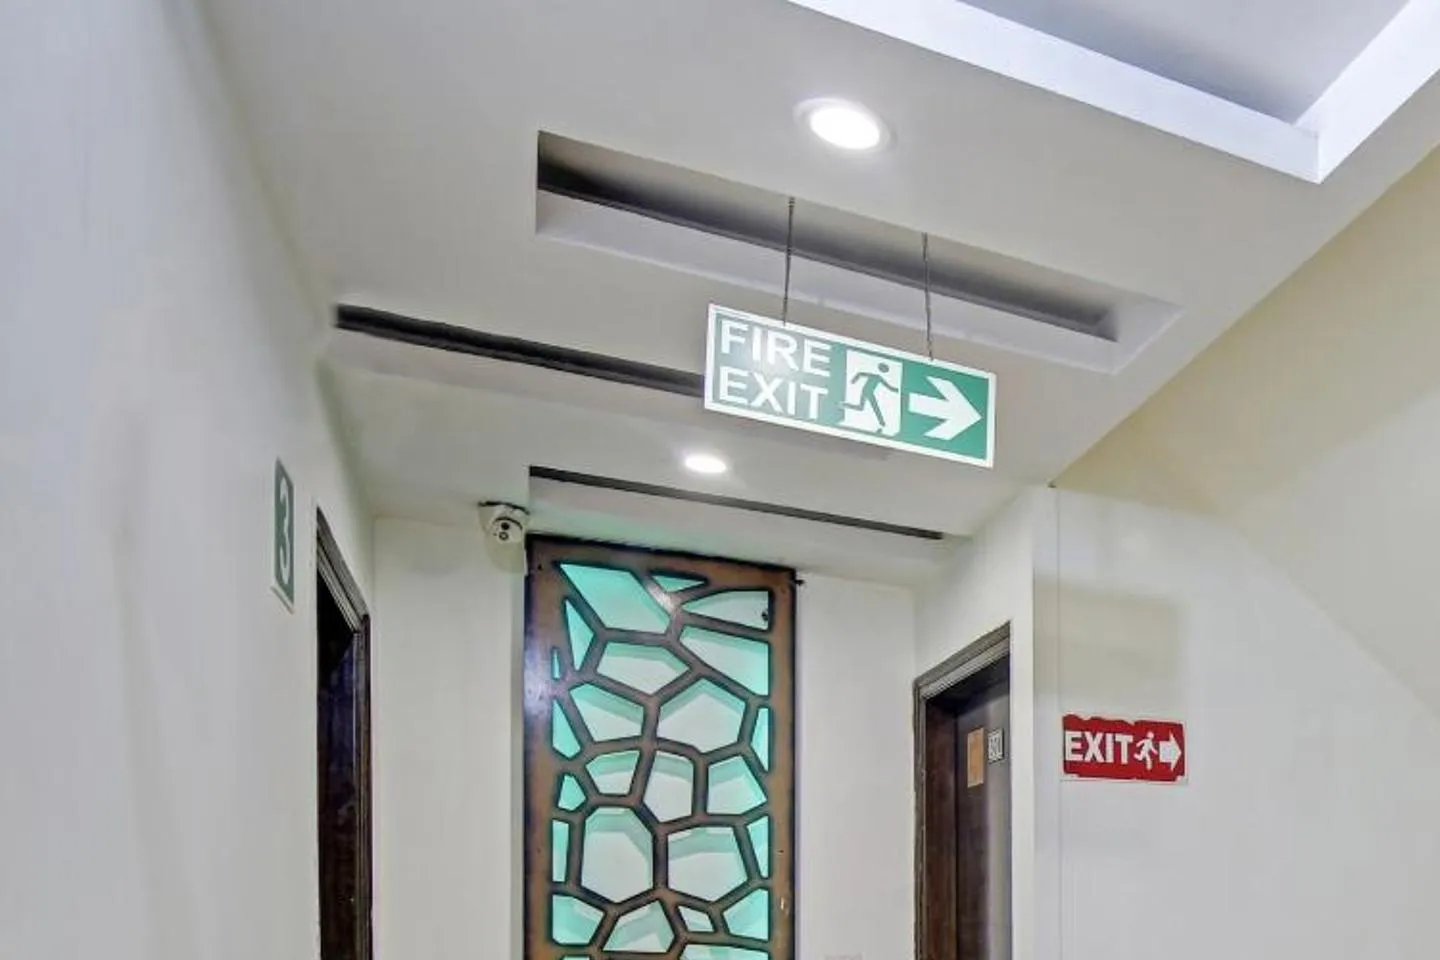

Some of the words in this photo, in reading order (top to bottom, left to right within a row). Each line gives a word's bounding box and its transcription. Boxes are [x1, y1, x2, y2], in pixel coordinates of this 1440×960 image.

[720, 320, 831, 377] FIRE
[719, 367, 828, 420] EXIT
[1064, 730, 1133, 764] EXIT
